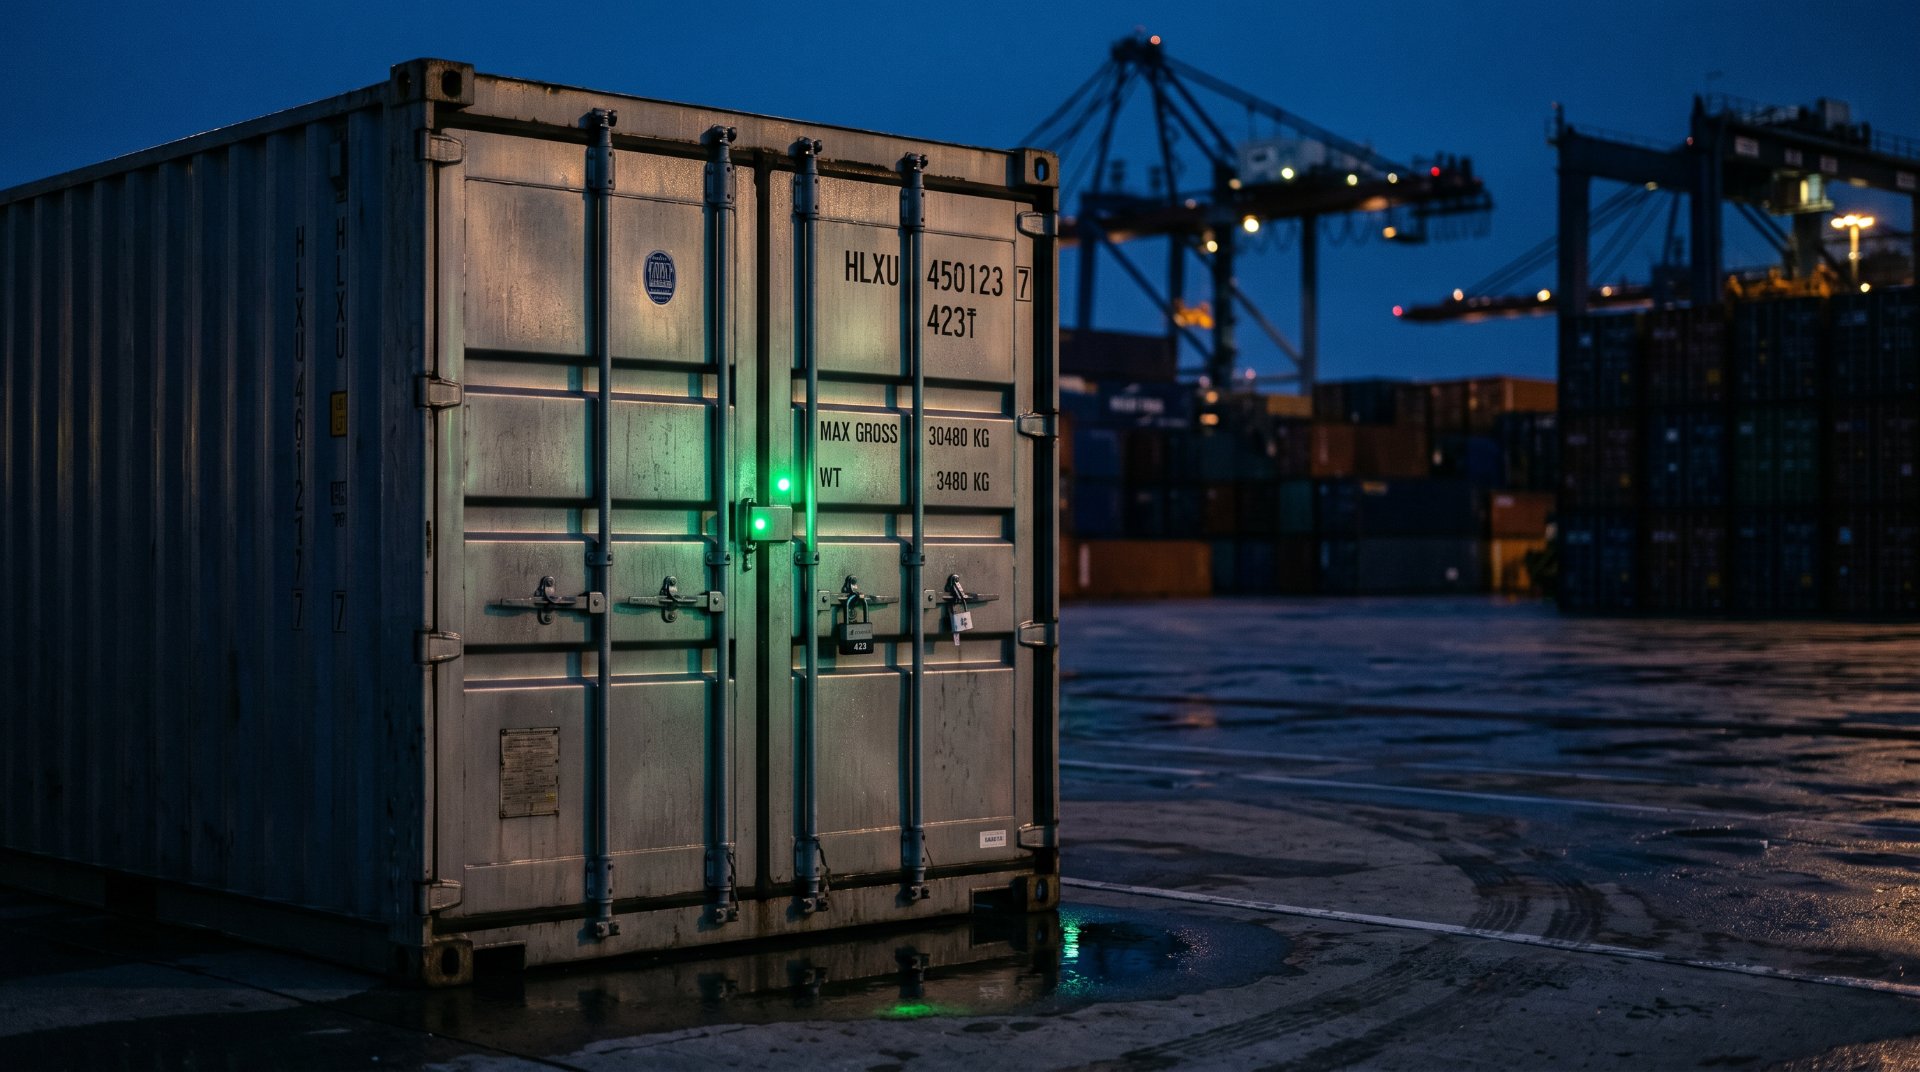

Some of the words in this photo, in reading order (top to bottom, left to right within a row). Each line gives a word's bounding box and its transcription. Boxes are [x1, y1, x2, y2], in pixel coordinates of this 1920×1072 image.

[295, 224, 305, 363] HLXU
[336, 215, 346, 360] HLXU
[845, 250, 899, 286] HLXU
[926, 259, 1003, 297] 450123
[1017, 269, 1029, 299] 7
[820, 421, 850, 443] MAX
[855, 422, 898, 444] GROSS
[928, 426, 968, 447] 30480
[973, 428, 990, 448] KG
[820, 467, 842, 488] WT
[936, 471, 968, 491] 3480
[973, 472, 990, 492] KG
[336, 593, 345, 631] 7
[854, 642, 867, 651] 423
